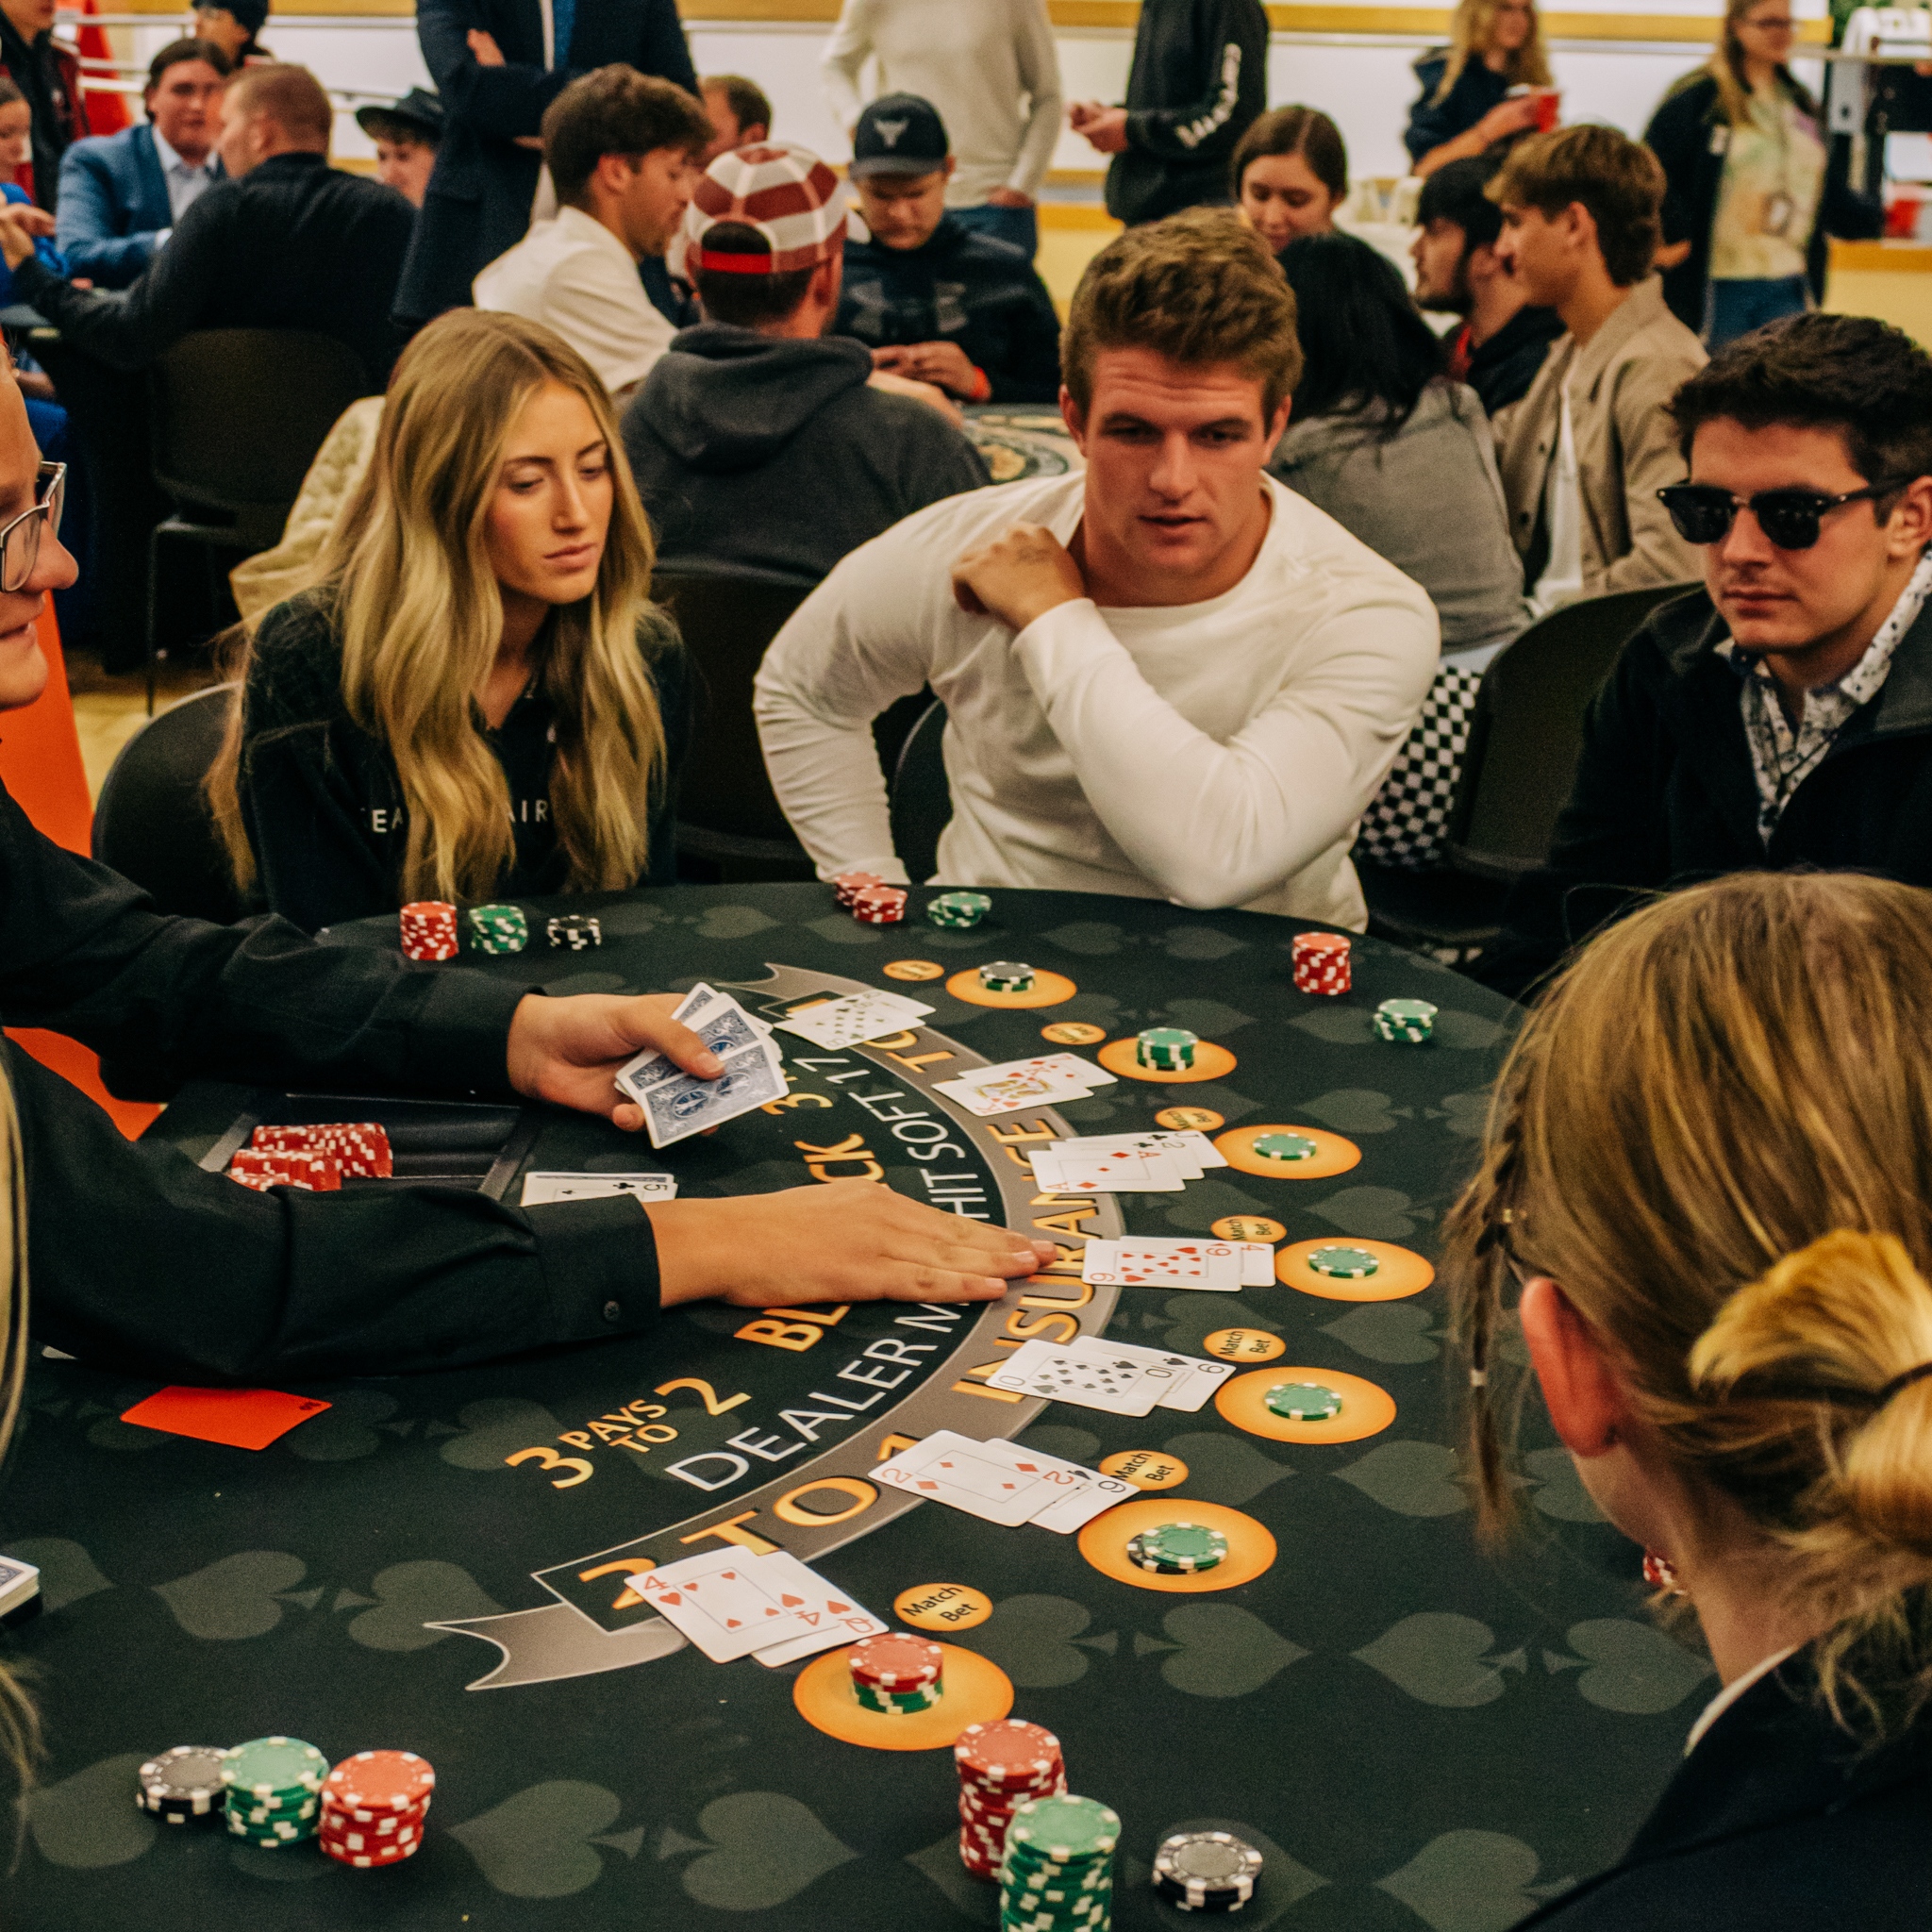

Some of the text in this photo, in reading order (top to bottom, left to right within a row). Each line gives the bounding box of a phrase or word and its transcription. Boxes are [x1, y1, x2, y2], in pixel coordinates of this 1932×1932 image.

[791, 1057, 871, 1085] 17
[848, 1091, 967, 1161] SOFT
[919, 1168, 991, 1220] HIT
[1224, 1218, 1274, 1241] Match Bet
[1218, 1330, 1271, 1357] Match Bet
[503, 1376, 752, 1490] 3 PAYS TO 2
[664, 1338, 939, 1492] DEALER
[1108, 1452, 1176, 1482] Match Bet
[678, 1474, 882, 1557] TO
[643, 1574, 670, 1591] 4
[901, 1586, 979, 1622] Match Bet
